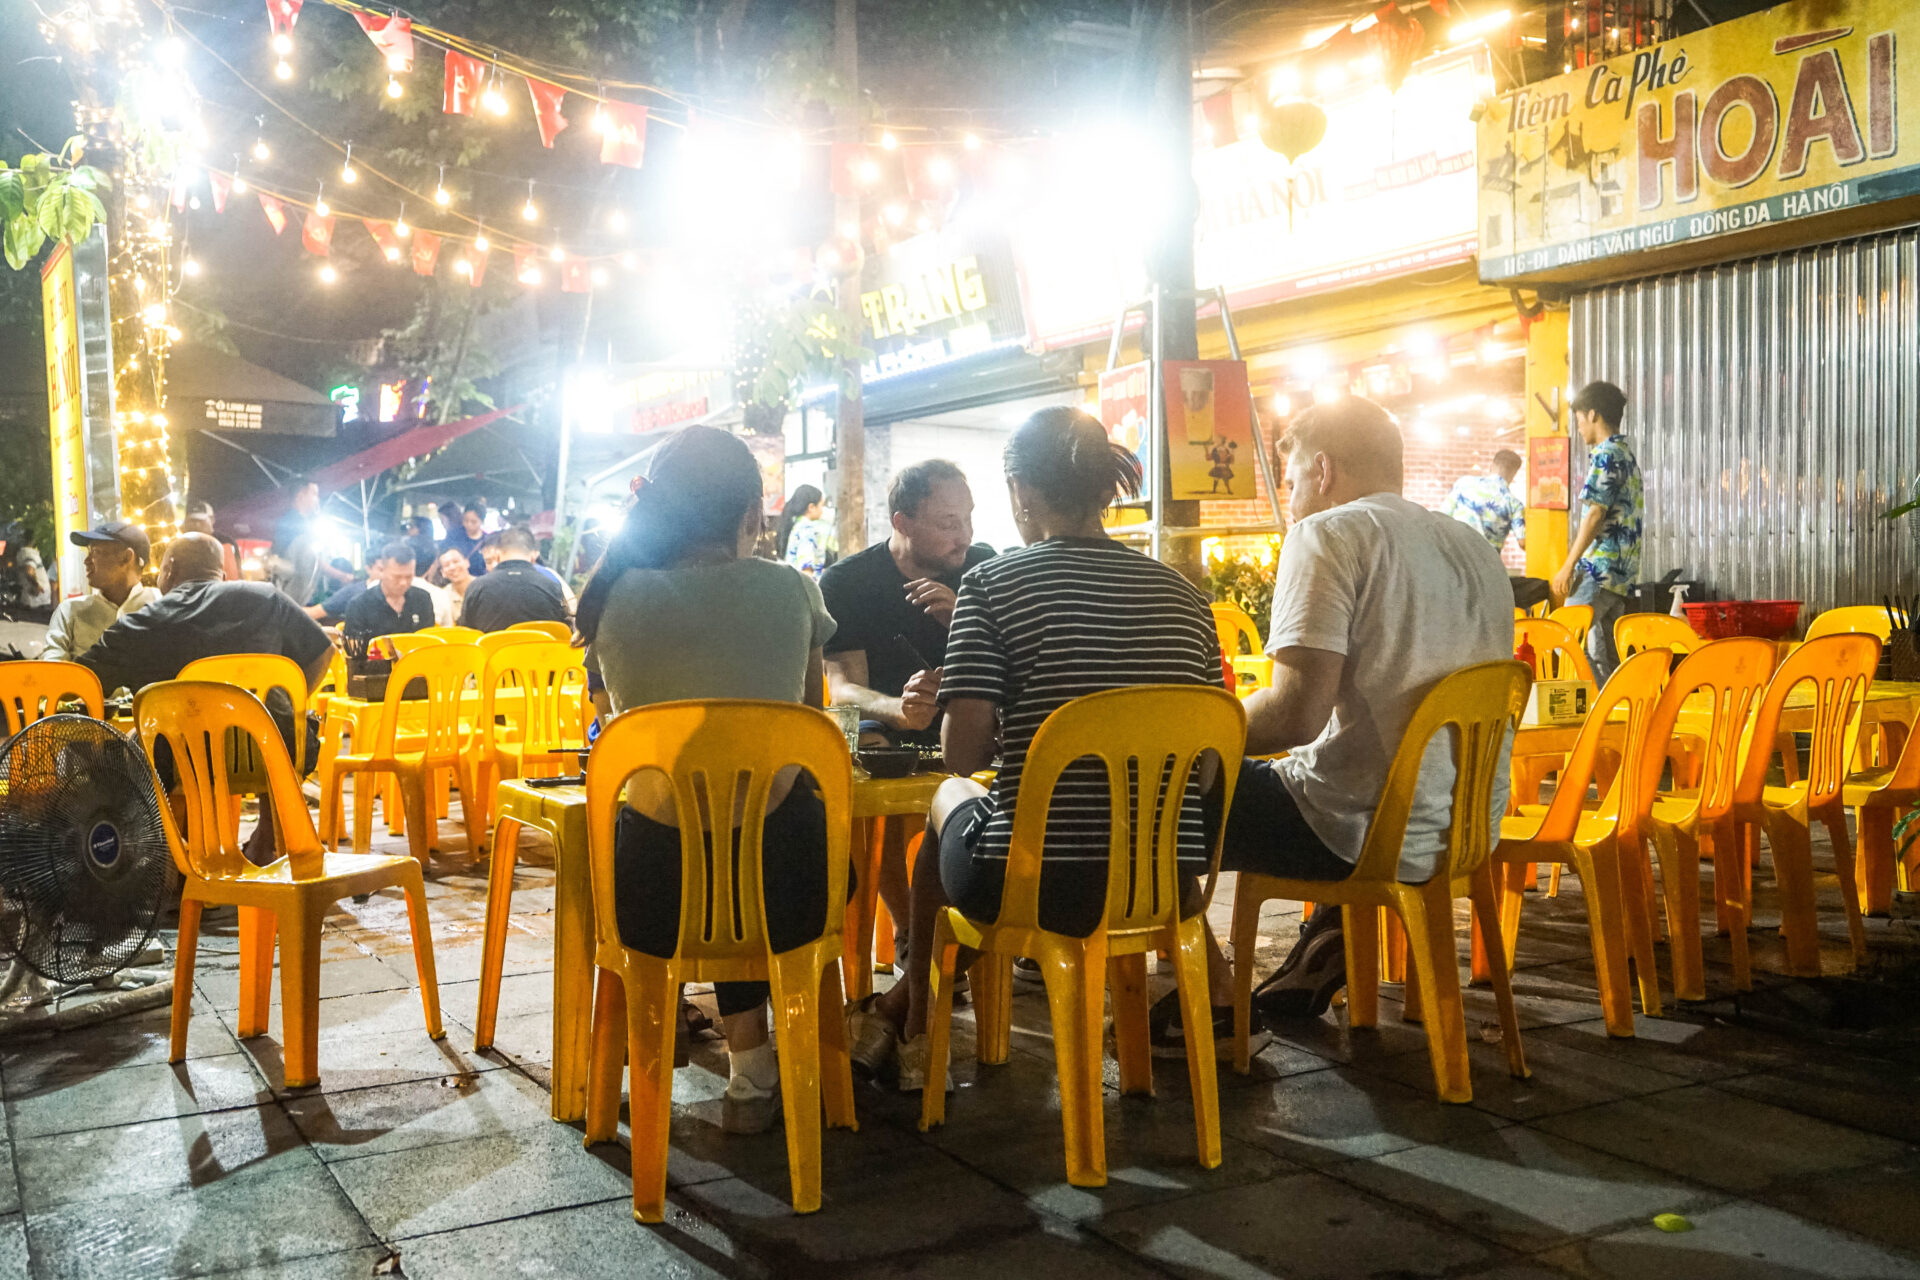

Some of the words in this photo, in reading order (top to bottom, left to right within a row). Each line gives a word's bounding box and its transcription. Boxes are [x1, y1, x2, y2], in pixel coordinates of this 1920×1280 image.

[1585, 65, 1623, 109] Cà
[1743, 202, 1772, 227] ĐA
[1783, 189, 1811, 218] HÀ
